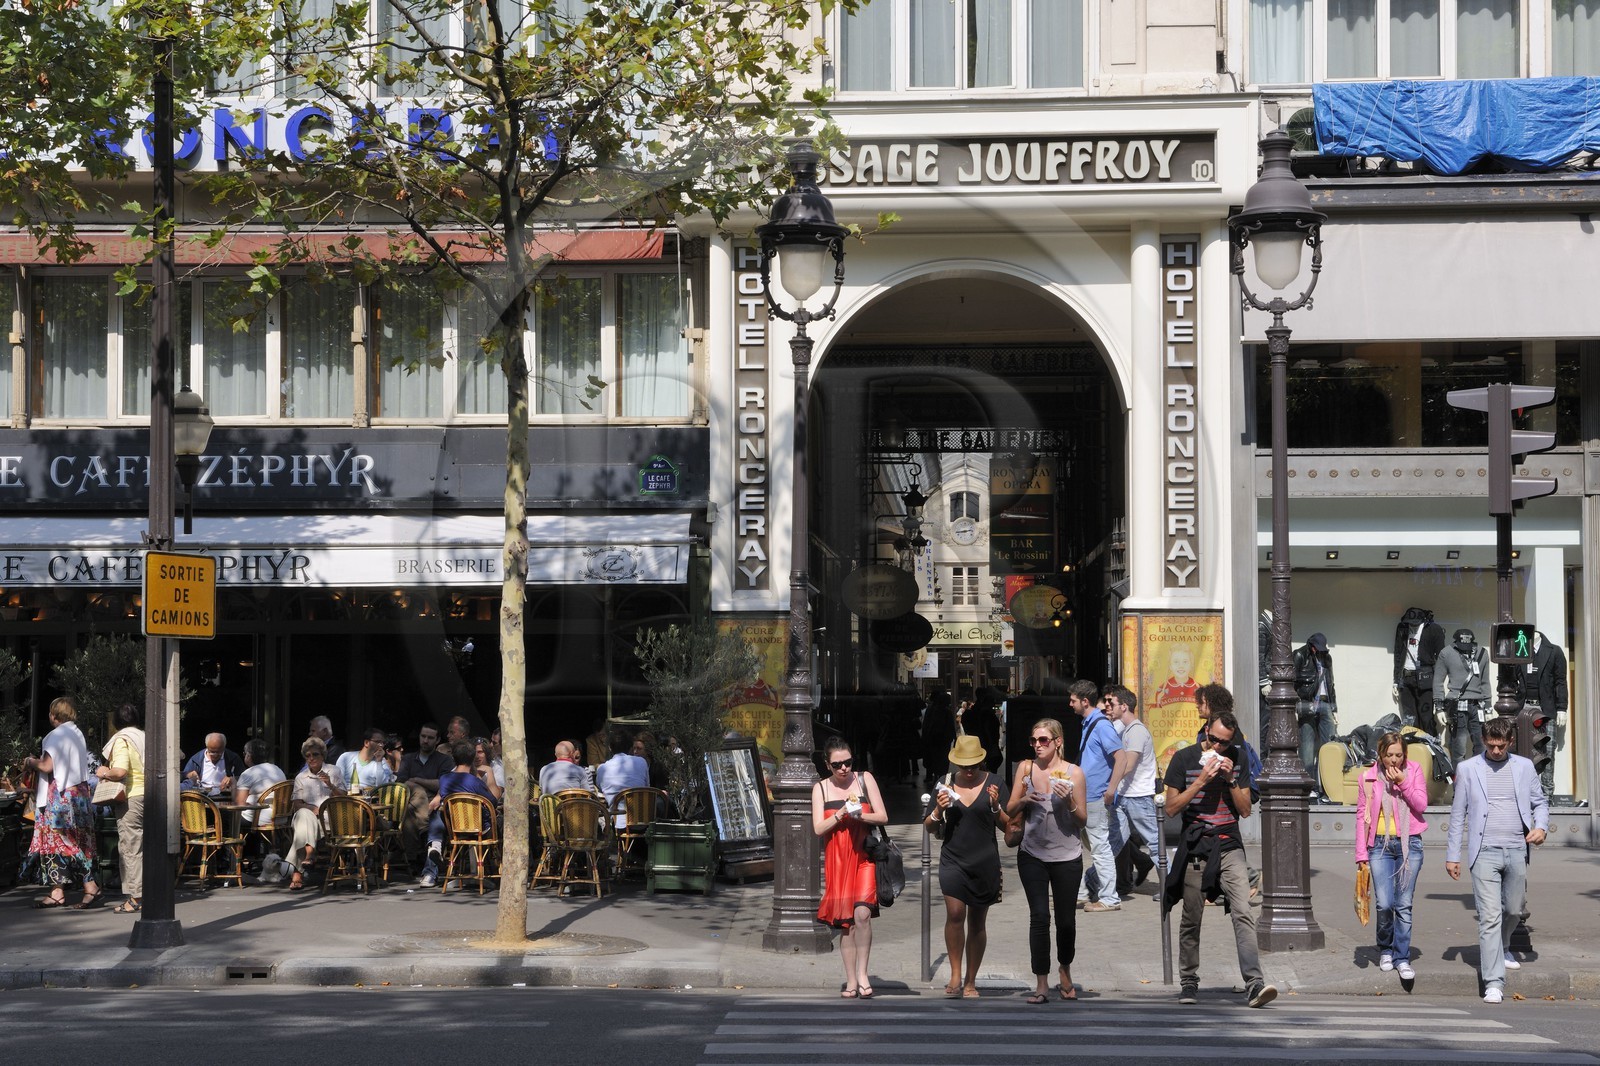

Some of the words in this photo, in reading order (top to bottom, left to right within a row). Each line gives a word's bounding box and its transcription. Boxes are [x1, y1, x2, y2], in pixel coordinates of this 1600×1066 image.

[88, 106, 572, 164] ONCER
[957, 139, 1181, 184] JOUFFROY
[1193, 162, 1212, 180] 10
[738, 245, 765, 373] HOTEL
[1165, 243, 1194, 370] HOTEL
[917, 430, 950, 449] THE
[50, 455, 151, 495] CAF
[197, 447, 381, 496] ZÉPHYR
[656, 474, 671, 482] CAFÉ
[993, 468, 1052, 478] RONRAY
[738, 386, 767, 588] RONCERAY
[1165, 384, 1197, 588] RONCERAY
[1010, 539, 1034, 549] BAR
[160, 564, 205, 583] SORTIE
[397, 558, 496, 575] BRASSERIE
[174, 588, 190, 604] DE
[151, 609, 210, 627] CAMIONS
[745, 626, 774, 635] CURE
[932, 627, 963, 642] Hôtel
[967, 627, 1002, 643] Cho
[1158, 625, 1173, 634] LA
[1174, 624, 1204, 634] CURE
[1149, 633, 1214, 643] GOURMANDE
[731, 711, 772, 719] BISCUITS
[1161, 709, 1197, 718] BISCUIT
[1152, 719, 1207, 728] CONFISERI
[738, 730, 781, 739] COLATS
[1152, 729, 1197, 738] CHOCOL
